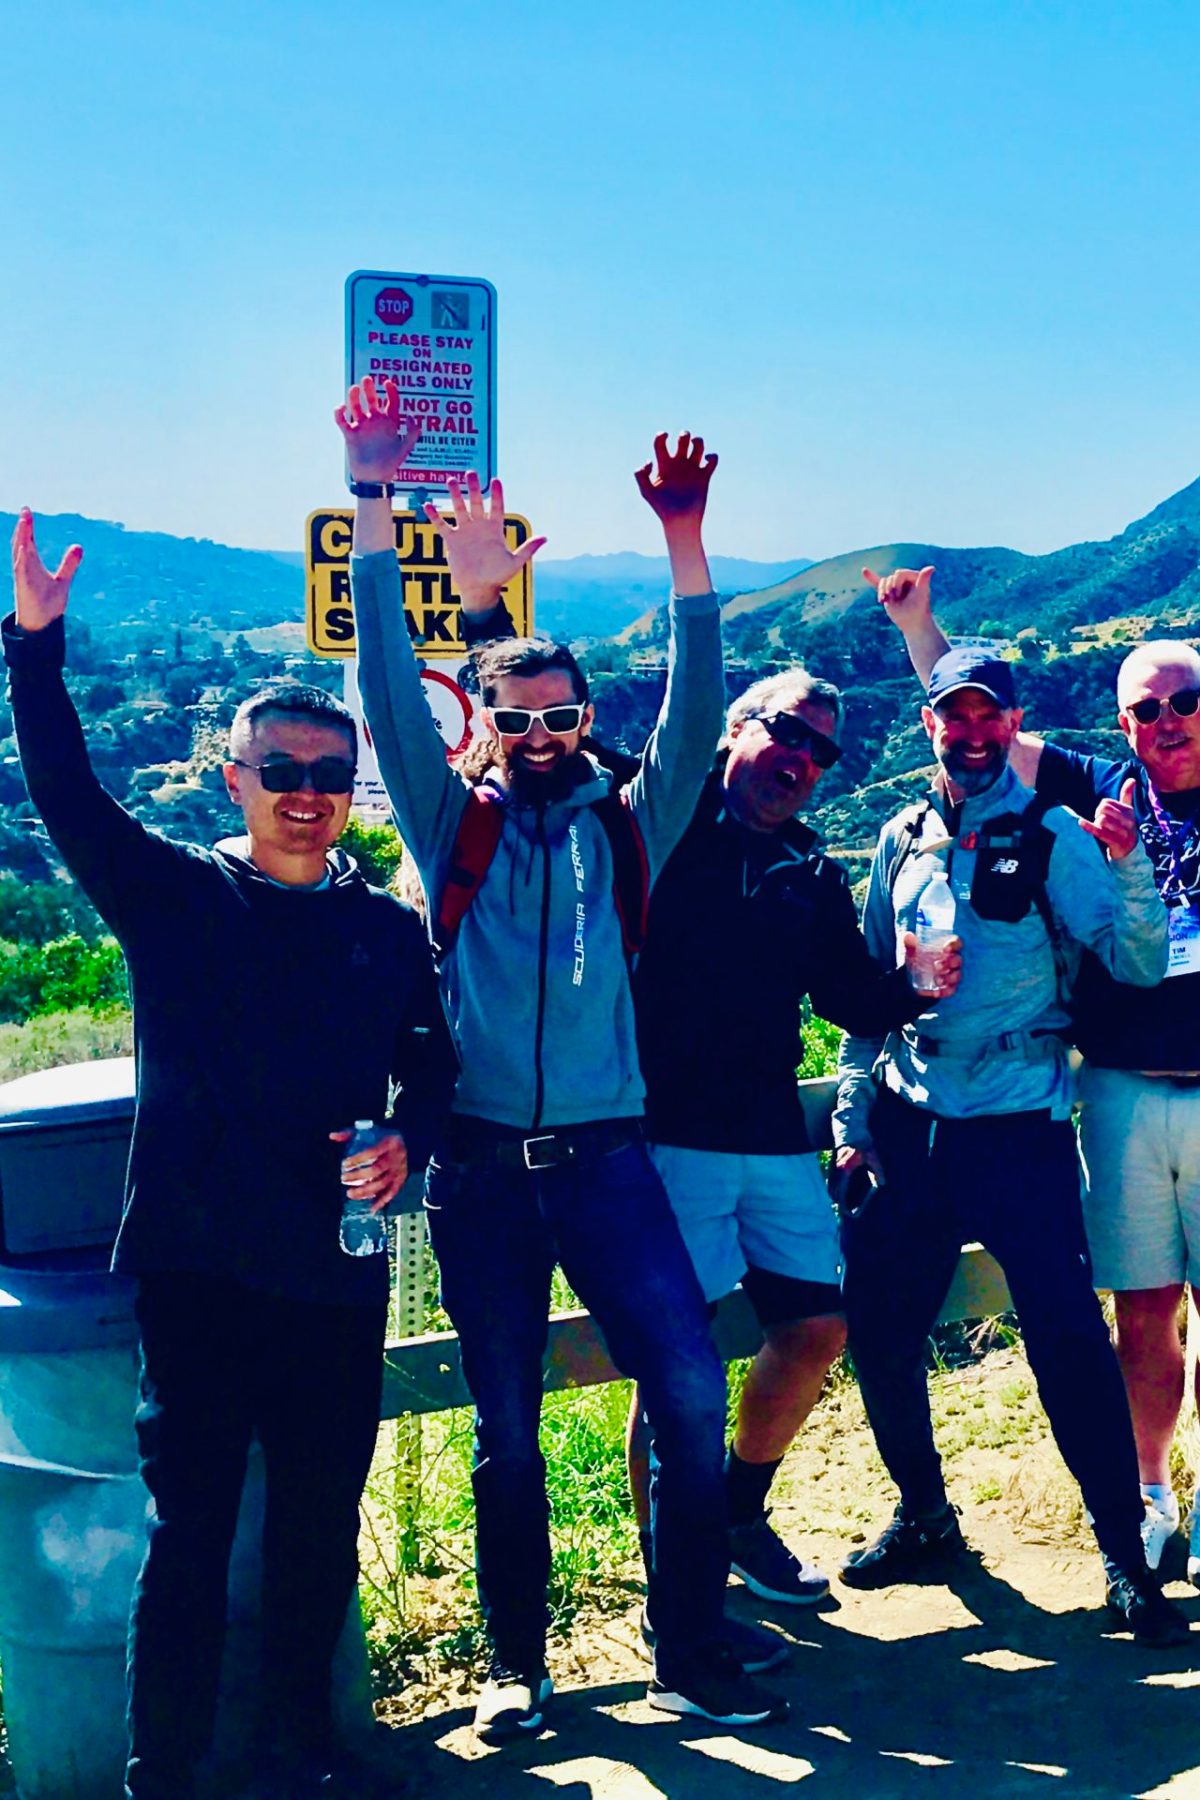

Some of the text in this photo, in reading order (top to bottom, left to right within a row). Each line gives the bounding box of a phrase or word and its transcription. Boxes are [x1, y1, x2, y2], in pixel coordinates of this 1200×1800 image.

[378, 299, 410, 314] STOP
[368, 331, 474, 349] PLEASE STAY
[412, 348, 432, 358] ON
[370, 358, 472, 375] DESIGNATED
[431, 376, 473, 390] ONLY
[403, 398, 440, 413] NOT
[445, 401, 473, 415] GO
[438, 437, 449, 445] BE
[451, 437, 476, 446] CITED
[1172, 946, 1186, 955] TIM
